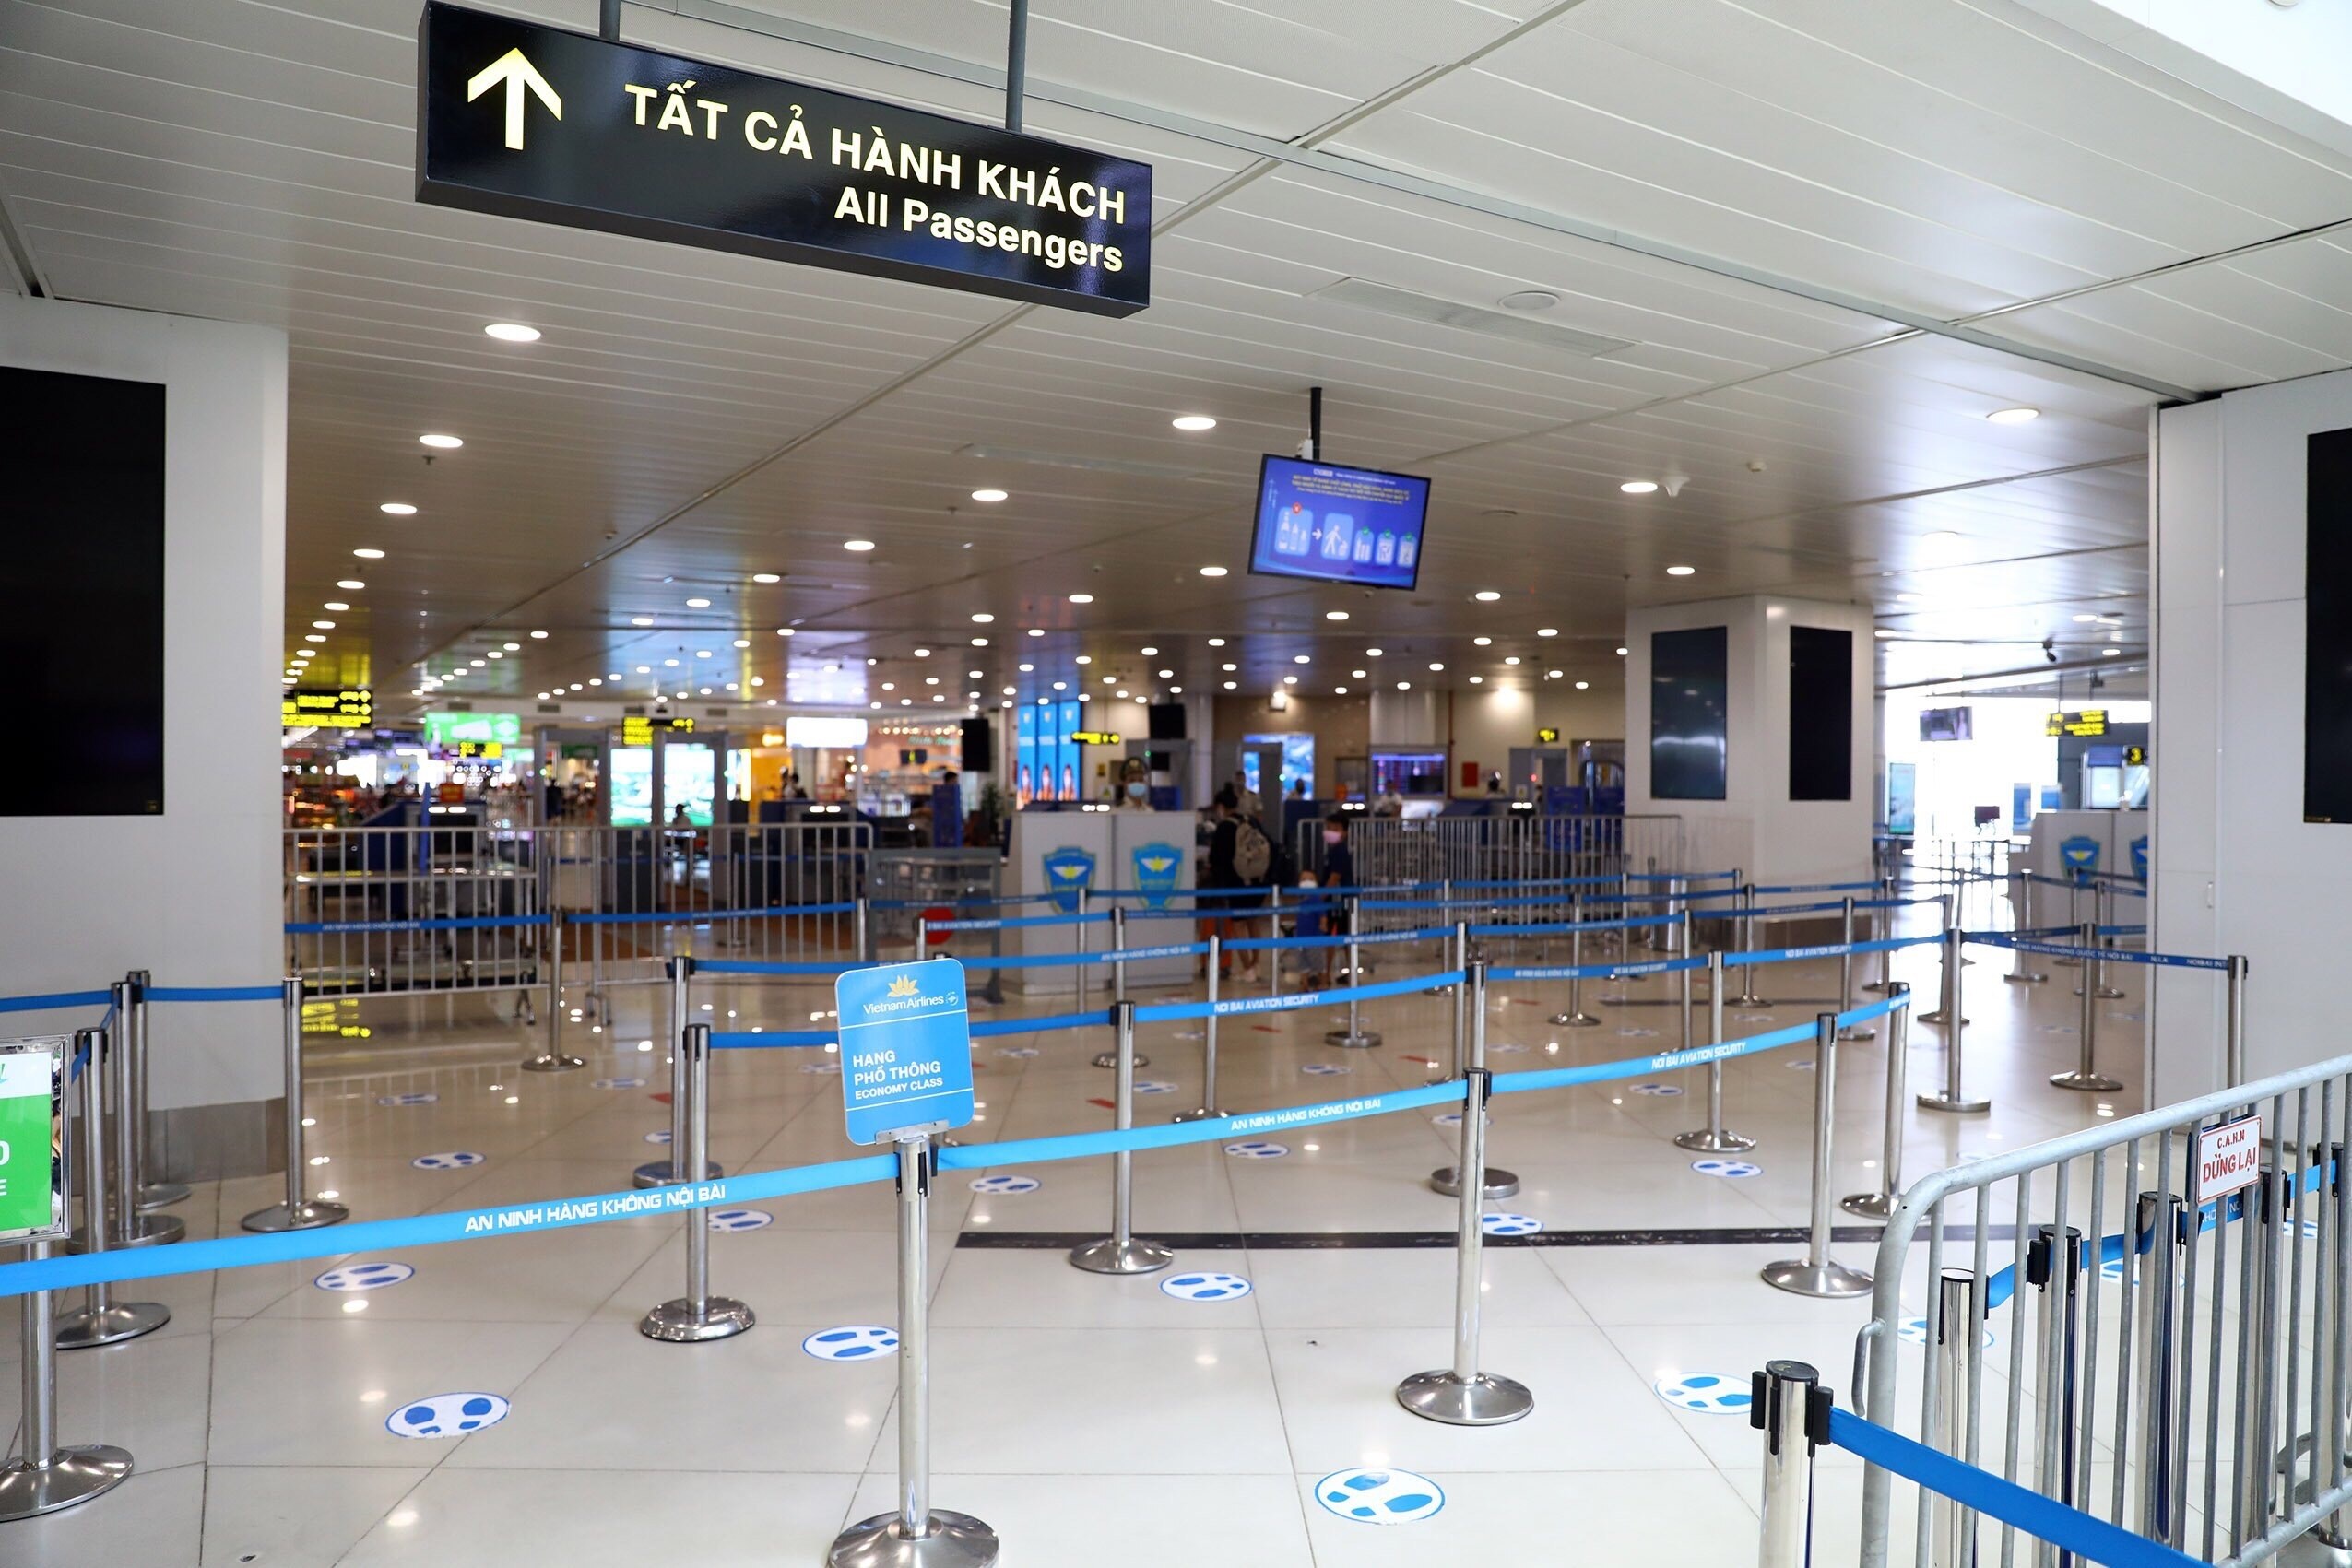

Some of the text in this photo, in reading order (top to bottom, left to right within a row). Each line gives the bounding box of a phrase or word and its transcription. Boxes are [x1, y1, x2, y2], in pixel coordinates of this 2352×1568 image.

[624, 79, 1124, 224] TẤT CẢ HÀNH KHÁCH
[834, 186, 1123, 272] All Passengers
[863, 996, 944, 1015] Vietnam Airlines
[853, 1050, 896, 1069] HẠNG
[1679, 1048, 1713, 1064] AVIATION
[1714, 1042, 1746, 1057] SECURITY
[854, 1060, 940, 1086] PHỔ THÔNG
[855, 1077, 943, 1100] ECONOMY CLASS
[2216, 1129, 2245, 1149] C.A.H.N
[2203, 1147, 2256, 1183] DỪNG LẠI
[465, 1183, 726, 1232] AN NINH HÀNG KHÔNG NỘI BÀI
